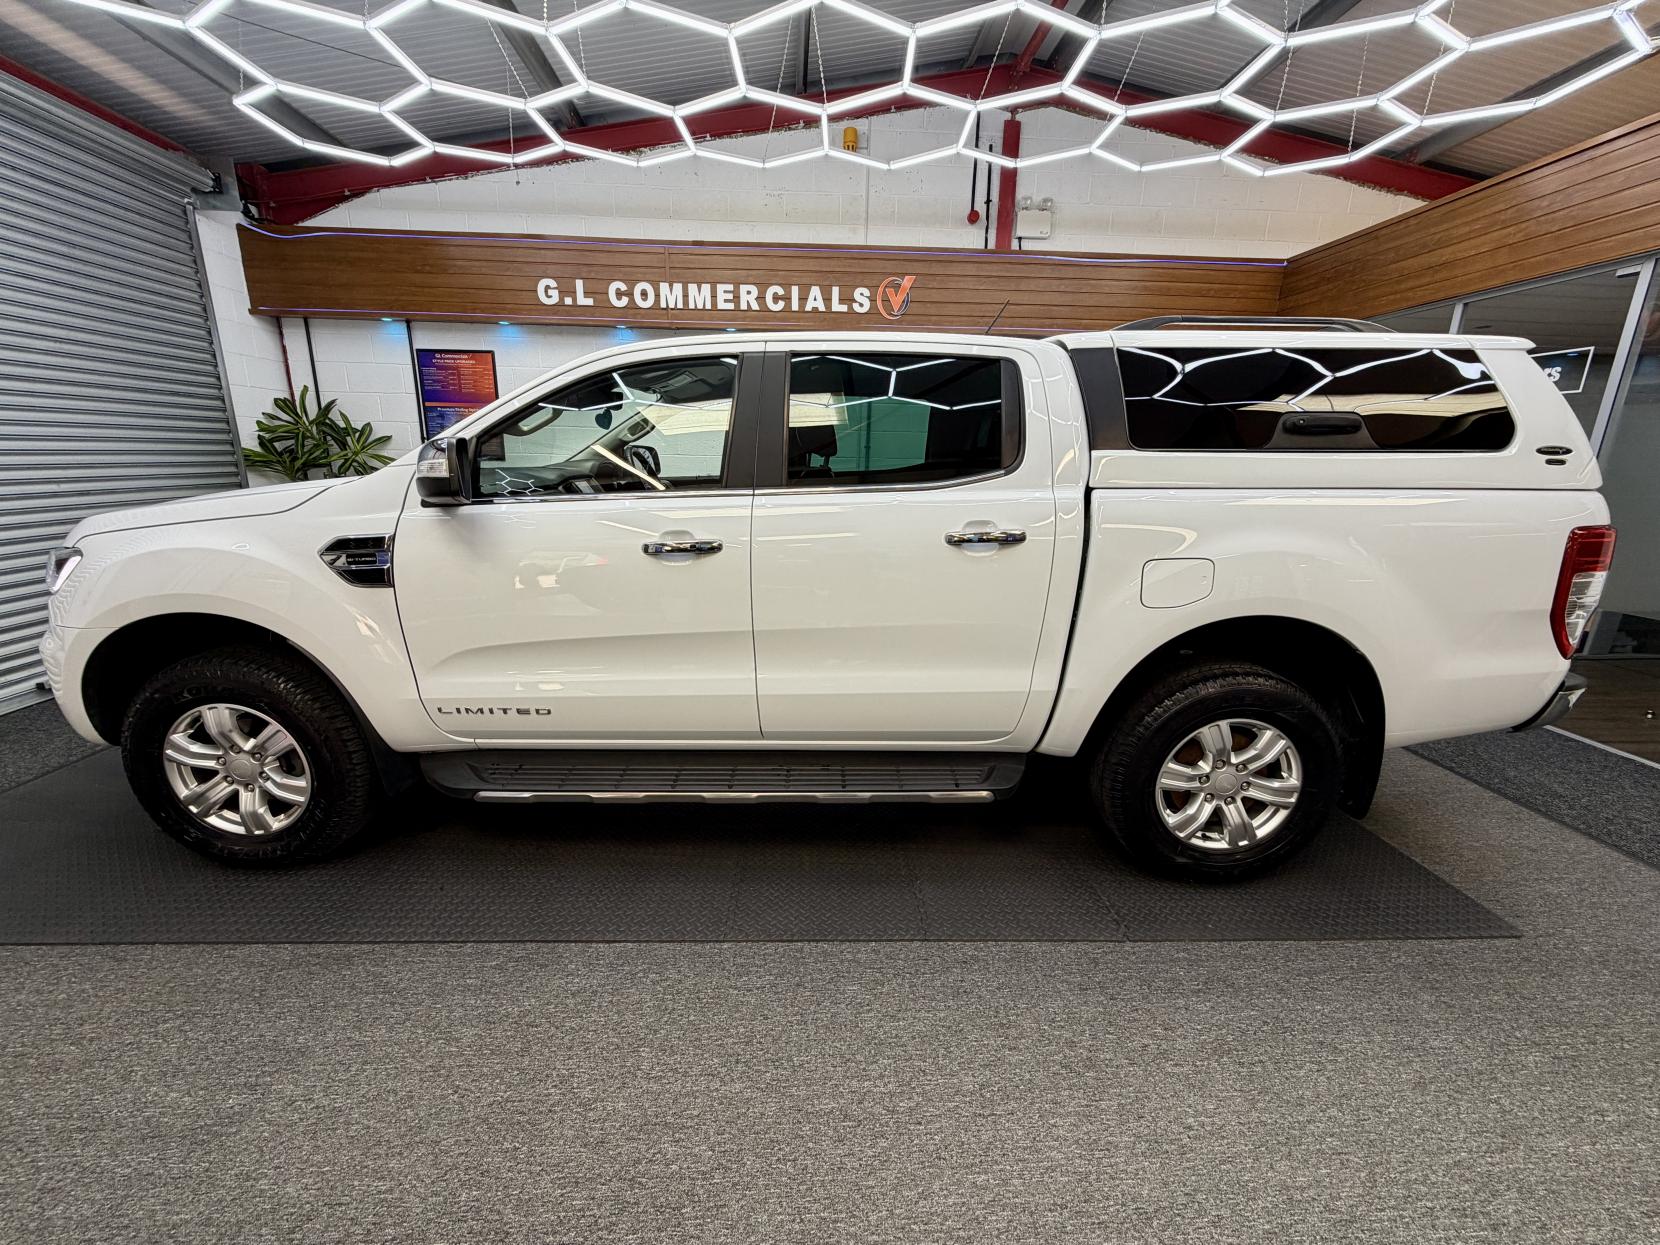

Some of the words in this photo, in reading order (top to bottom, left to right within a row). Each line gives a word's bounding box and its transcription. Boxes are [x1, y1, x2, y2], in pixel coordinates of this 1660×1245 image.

[537, 278, 594, 305] G.L
[608, 281, 871, 313] COMMERCIALS
[437, 706, 552, 716] LIMITED
